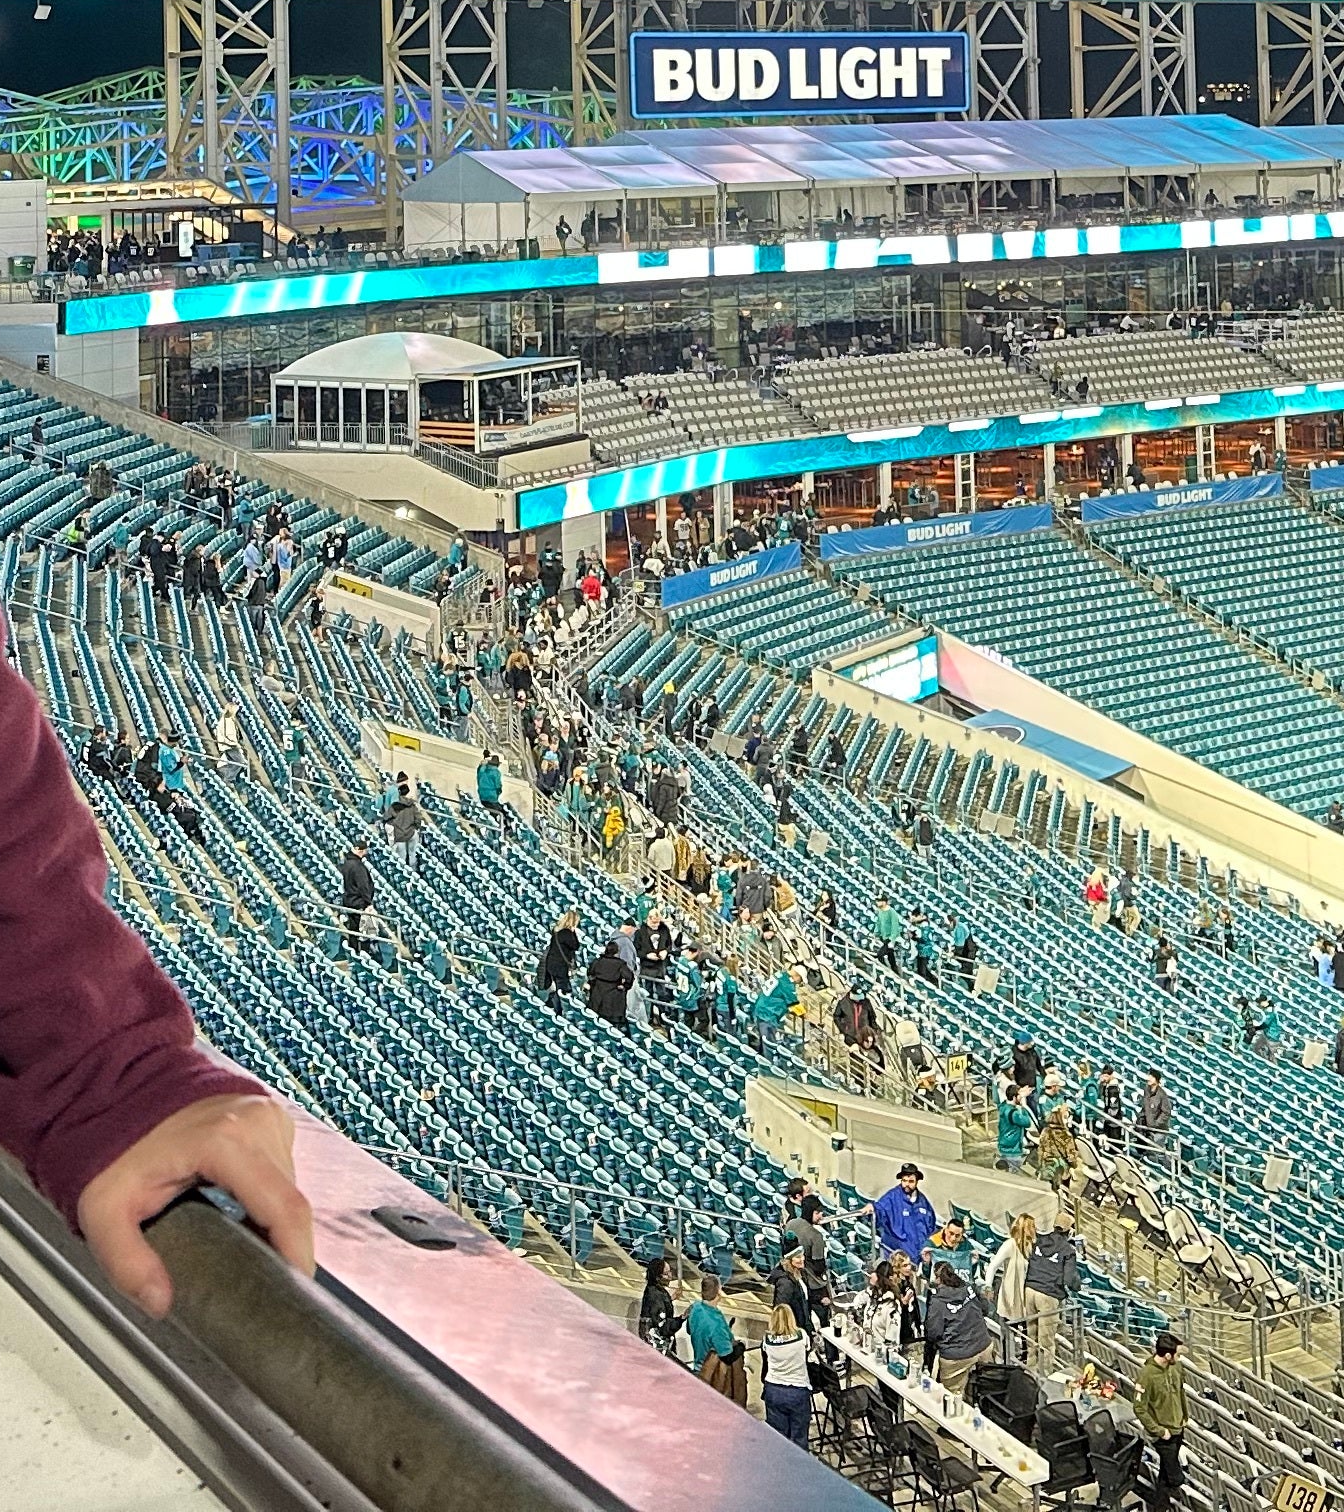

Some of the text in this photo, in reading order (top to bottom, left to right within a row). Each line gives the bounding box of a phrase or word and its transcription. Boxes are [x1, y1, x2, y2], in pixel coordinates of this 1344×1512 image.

[652, 46, 951, 102] BUD LIGHT
[1157, 488, 1213, 506] BUD LIGHT
[907, 521, 972, 541] BUD LIGHT
[710, 561, 757, 586] BUD LIGHT
[950, 1059, 964, 1072] 141
[1285, 1482, 1317, 1512] 138
